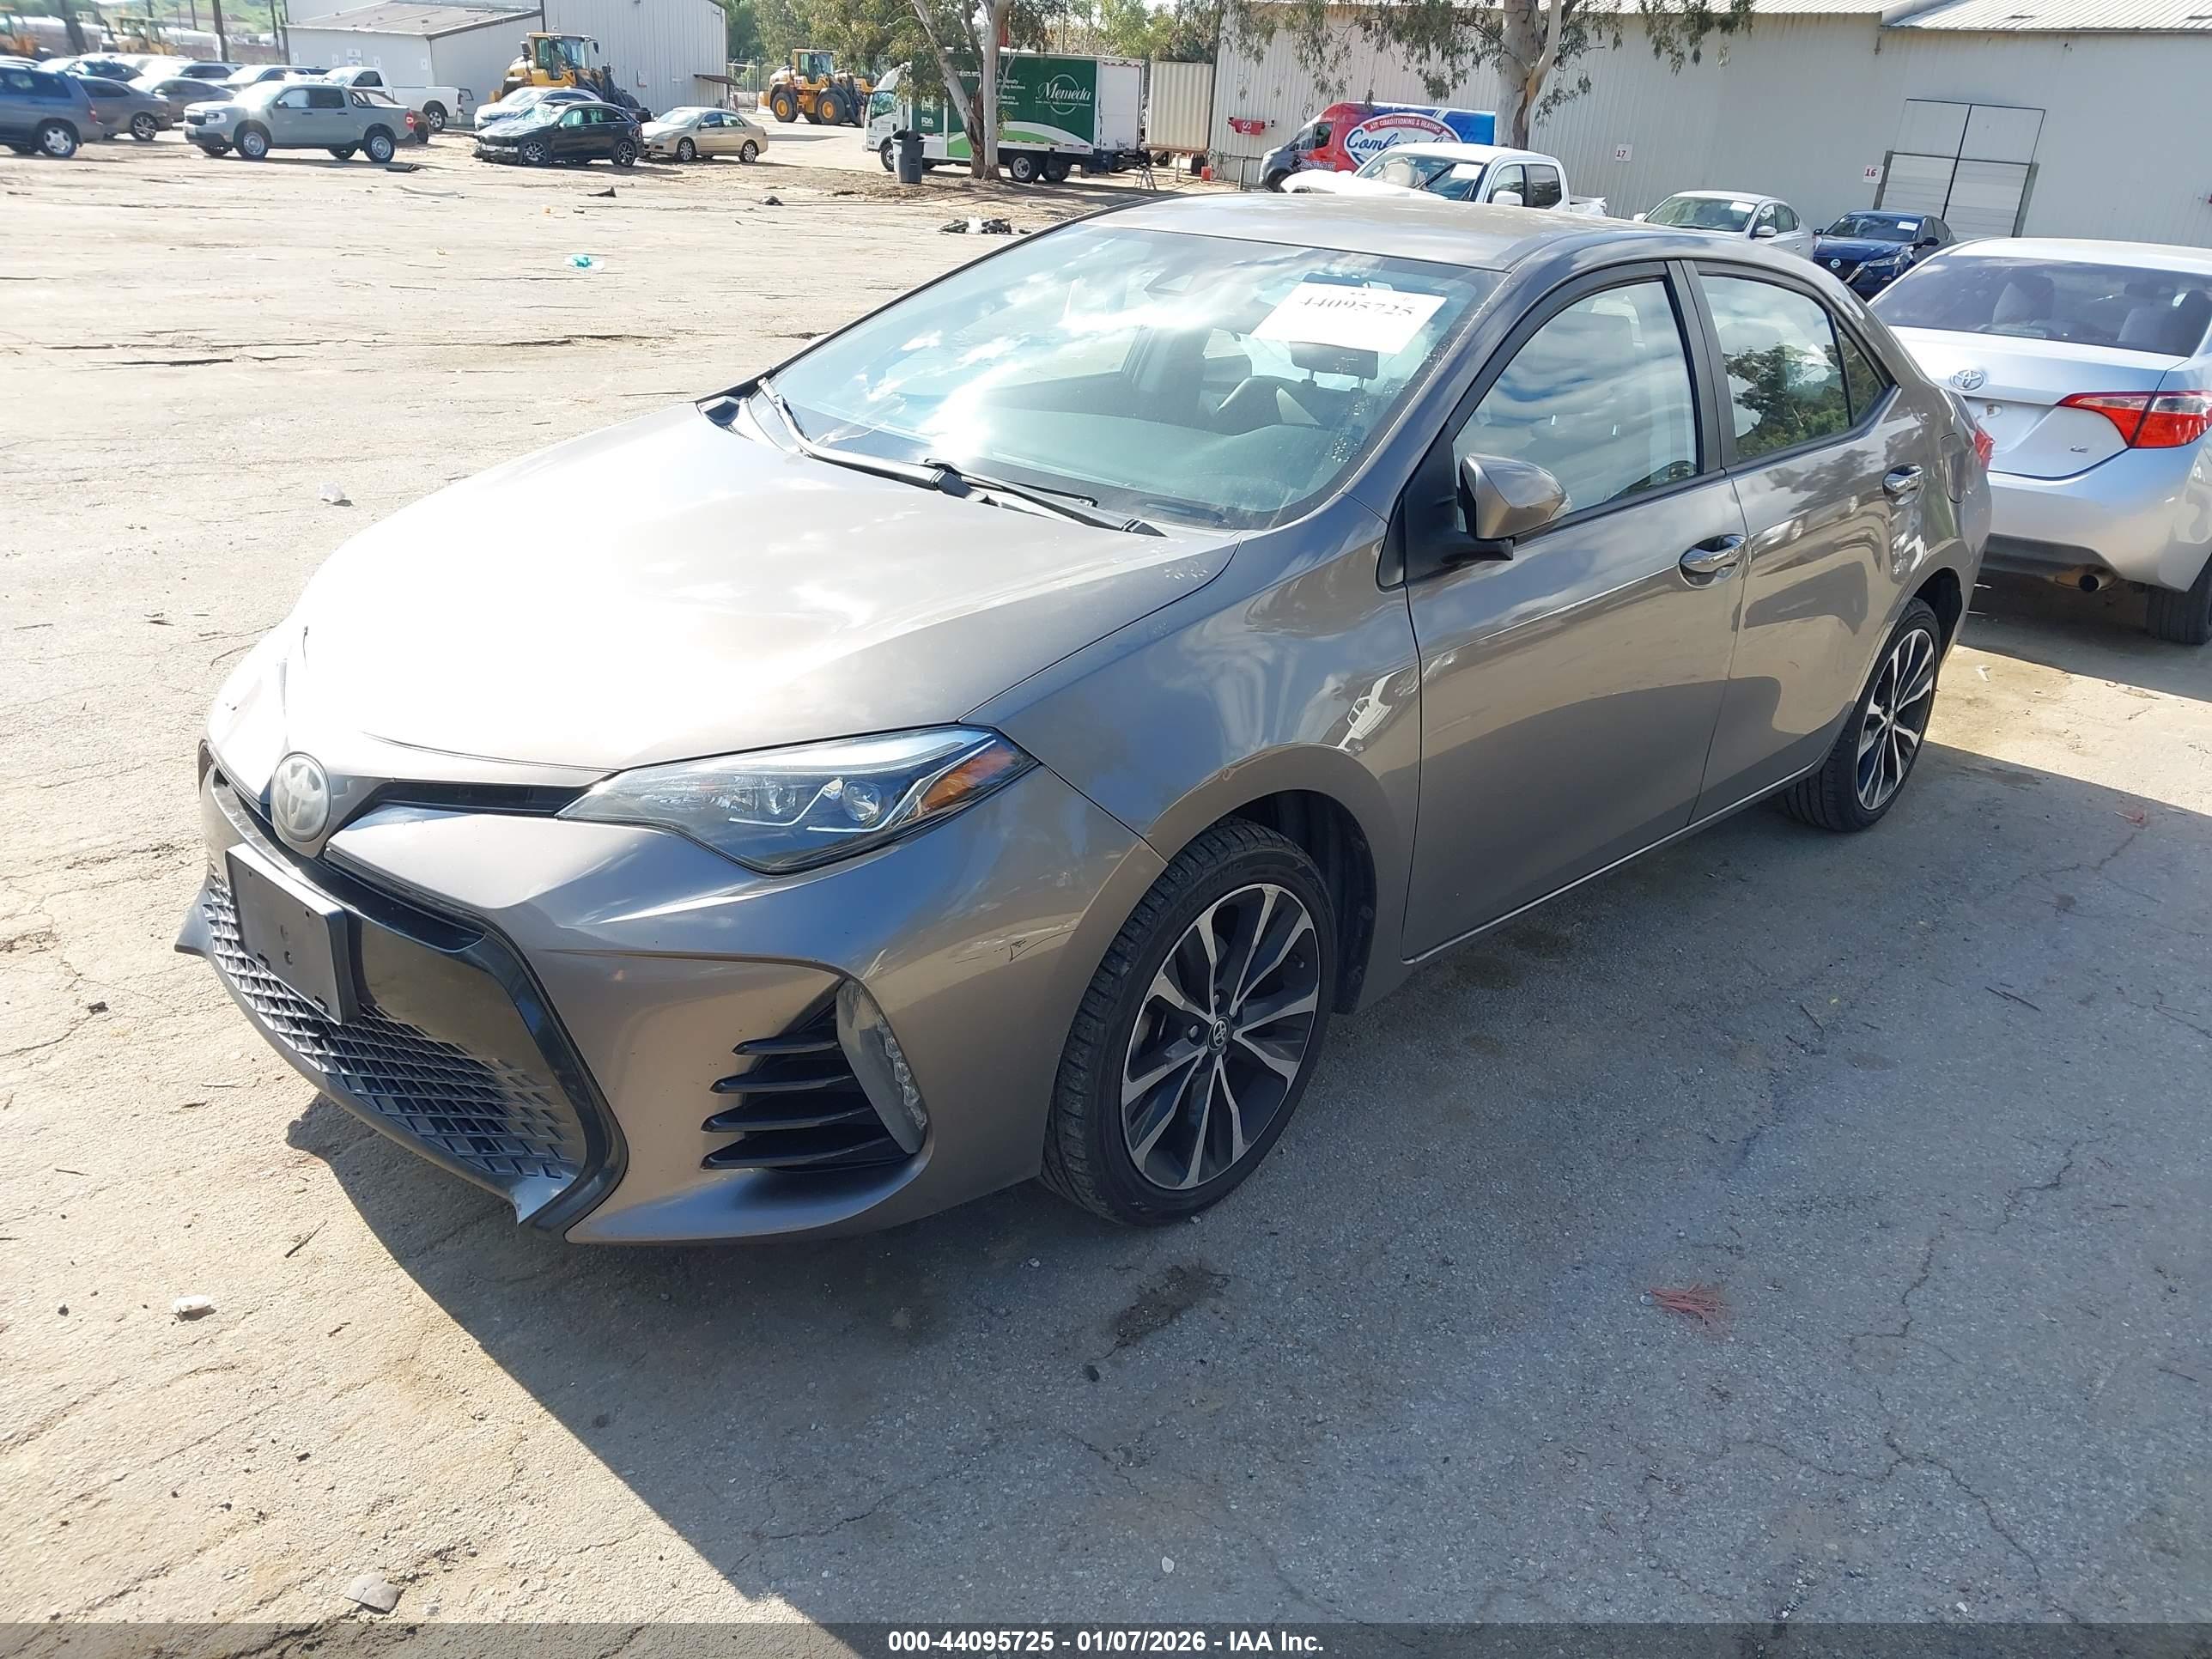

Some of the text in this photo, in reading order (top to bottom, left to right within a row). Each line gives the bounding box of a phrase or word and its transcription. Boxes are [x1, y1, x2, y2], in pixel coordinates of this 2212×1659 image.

[1036, 82, 1091, 101] Memeda
[1370, 122, 1379, 131] AIR
[1379, 118, 1415, 126] CONDITIONING
[1420, 121, 1442, 132] HEATING
[1616, 149, 1626, 159] 17
[1864, 168, 1877, 177] 16
